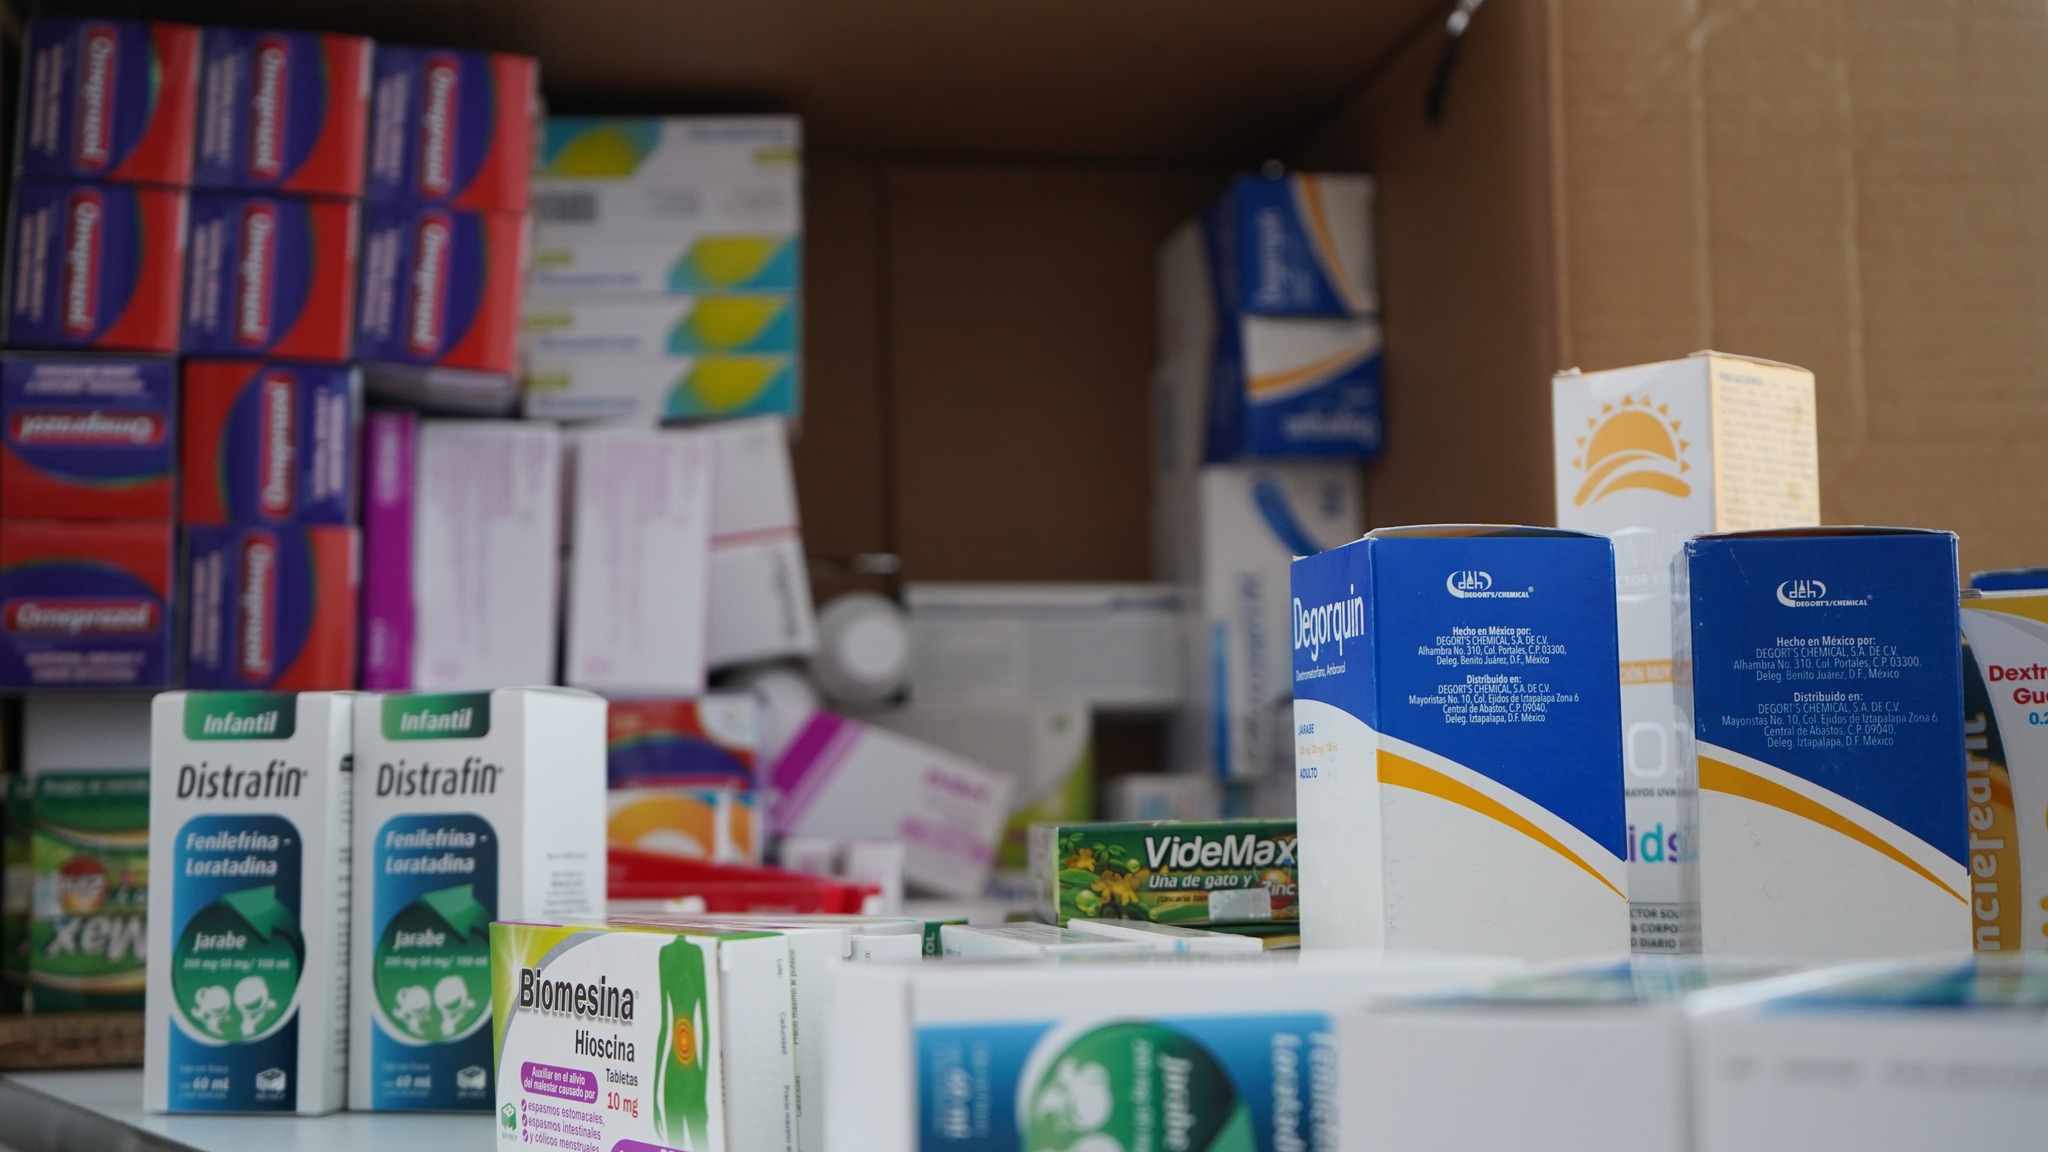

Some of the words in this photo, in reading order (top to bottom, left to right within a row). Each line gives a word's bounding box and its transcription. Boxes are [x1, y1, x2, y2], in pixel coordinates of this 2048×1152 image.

[1293, 584, 1364, 662] Degorquin
[1453, 627, 1476, 636] Hecho
[1478, 628, 1487, 636] en
[1489, 626, 1516, 636] México
[1516, 627, 1531, 638] por:
[1436, 636, 1471, 646] DEGORT'S
[1472, 636, 1510, 646] CHEMICAL,
[1511, 636, 1524, 646] S.A.
[1526, 636, 1536, 645] DE
[1536, 636, 1548, 645] C.V.
[1776, 637, 1806, 647] Hecho
[1808, 638, 1820, 646] en
[1822, 636, 1855, 646] México
[1857, 637, 1876, 648] por:
[1418, 646, 1452, 656] Alhambra
[1453, 646, 1465, 655] No.
[1466, 646, 1483, 656] 310,
[1484, 646, 1498, 655] Col.
[1498, 646, 1528, 656] Portales,
[1528, 645, 1542, 654] C.P.
[1542, 645, 1567, 656] 03300,
[1756, 648, 1799, 659] DEGORT'S
[1800, 647, 1850, 659] CHEMICAL,
[1850, 646, 1867, 658] S.A.
[1869, 646, 1880, 656] DE
[1883, 646, 1898, 656] C.V.
[1436, 656, 1460, 668] Deleg.
[1460, 656, 1483, 665] Benito
[1484, 655, 1509, 666] Juárez,
[1510, 655, 1524, 666] D.F.,
[1526, 654, 1550, 664] México
[1734, 659, 1776, 670] Alhambra
[1777, 660, 1792, 669] No.
[1794, 659, 1814, 670] 310,
[1816, 658, 1832, 668] Col.
[1834, 658, 1871, 670] Portales,
[1872, 658, 1888, 668] C.P.
[1890, 656, 1922, 668] 03300,
[1466, 674, 1508, 684] Distribuido
[1509, 676, 1522, 684] en:
[1756, 670, 1784, 684] Deleg.
[1786, 670, 1814, 680] Benito
[1816, 669, 1847, 681] Juárez,
[1848, 669, 1866, 680] D.F.,
[1868, 668, 1900, 678] México
[1989, 663, 2048, 681] Dextr
[1438, 685, 1473, 694] DEGORT'S
[1474, 684, 1512, 695] CHEMICAL,
[1513, 684, 1526, 694] S.A.
[1528, 684, 1538, 694] DE
[1538, 684, 1550, 693] C.V.
[1794, 692, 1846, 702] Distribuido
[1848, 693, 1864, 702] en:
[2013, 687, 2048, 704] Gu
[1408, 695, 1447, 706] Mayoristas
[1448, 694, 1460, 704] No.
[1461, 694, 1473, 705] 10,
[1474, 694, 1488, 704] Col.
[1488, 694, 1510, 706] Ejidos
[1510, 694, 1520, 703] de
[1520, 694, 1555, 705] Iztapalapa
[1556, 693, 1573, 702] Zona
[1574, 693, 1580, 702] 6
[1443, 704, 1468, 714] Central
[1469, 704, 1478, 713] de
[1480, 703, 1508, 714] Abastos,
[1508, 703, 1522, 712] C.P.
[1522, 702, 1548, 714] 09040,
[1758, 704, 1801, 715] DEGORT'S
[1803, 703, 1851, 714] CHEMICAL,
[1853, 702, 1870, 713] S.A.
[1872, 702, 1883, 712] DE
[1886, 702, 1900, 712] C.V.
[203, 710, 278, 735] Infantil
[400, 707, 473, 732] Infantil
[1446, 714, 1470, 726] Deleg.
[1470, 714, 1506, 725] Iztapalapa,
[1508, 713, 1520, 722] D.F.
[1522, 712, 1546, 722] México
[1722, 716, 1768, 729] Mayoristas
[1770, 715, 1785, 726] No.
[1787, 714, 1801, 726] 10,
[1802, 714, 1820, 724] Col.
[1821, 714, 1848, 727] Ejidos
[1849, 714, 1860, 724] de
[1862, 712, 1906, 727] Iztapalapa
[1908, 712, 1930, 722] Zona
[1931, 712, 1938, 722] 6
[1299, 723, 1314, 736] JARABE
[1764, 726, 1795, 736] Central
[1796, 726, 1808, 736] de
[1810, 725, 1846, 736] Abastos,
[1847, 724, 1863, 735] C.P.
[1864, 724, 1896, 736] 09040,
[1767, 738, 1796, 751] Deleg.
[1797, 737, 1844, 750] Iztapalapa,
[1846, 736, 1862, 746] D.F.
[1862, 734, 1894, 746] México
[176, 758, 302, 799] Distrafin
[376, 755, 497, 797] Distrafin
[1300, 767, 1318, 779] ADULTO
[186, 830, 279, 851] Fenilefrina
[385, 827, 476, 849] Fenilefrina
[1145, 834, 1297, 868] VideMax
[185, 855, 278, 878] Loratadina
[384, 852, 476, 874] Loratadina
[1150, 875, 1177, 888] Uña
[1182, 874, 1200, 888] de
[1205, 875, 1238, 890] gato
[1243, 875, 1252, 886] y
[193, 931, 247, 954] Jarabe
[392, 928, 445, 952] Jarabe
[520, 968, 634, 1020] Biomesina
[575, 1030, 635, 1063] Hioscina
[532, 1066, 554, 1080] Auxiliar
[554, 1072, 561, 1080] en
[562, 1071, 568, 1082] el
[570, 1072, 585, 1086] alivio
[606, 1068, 639, 1087] Tabletas
[524, 1078, 532, 1088] del
[534, 1079, 558, 1094] malestar
[558, 1084, 584, 1098] causado
[584, 1090, 596, 1101] por
[607, 1092, 620, 1111] 10
[622, 1098, 639, 1118] mg
[528, 1102, 560, 1118] espasmos
[562, 1109, 604, 1127] estomacales,
[528, 1117, 561, 1133] espasmos
[562, 1121, 602, 1140] intestinales
[530, 1133, 534, 1144] y
[534, 1131, 558, 1147] cólicos
[560, 1138, 600, 1152] menstruales
